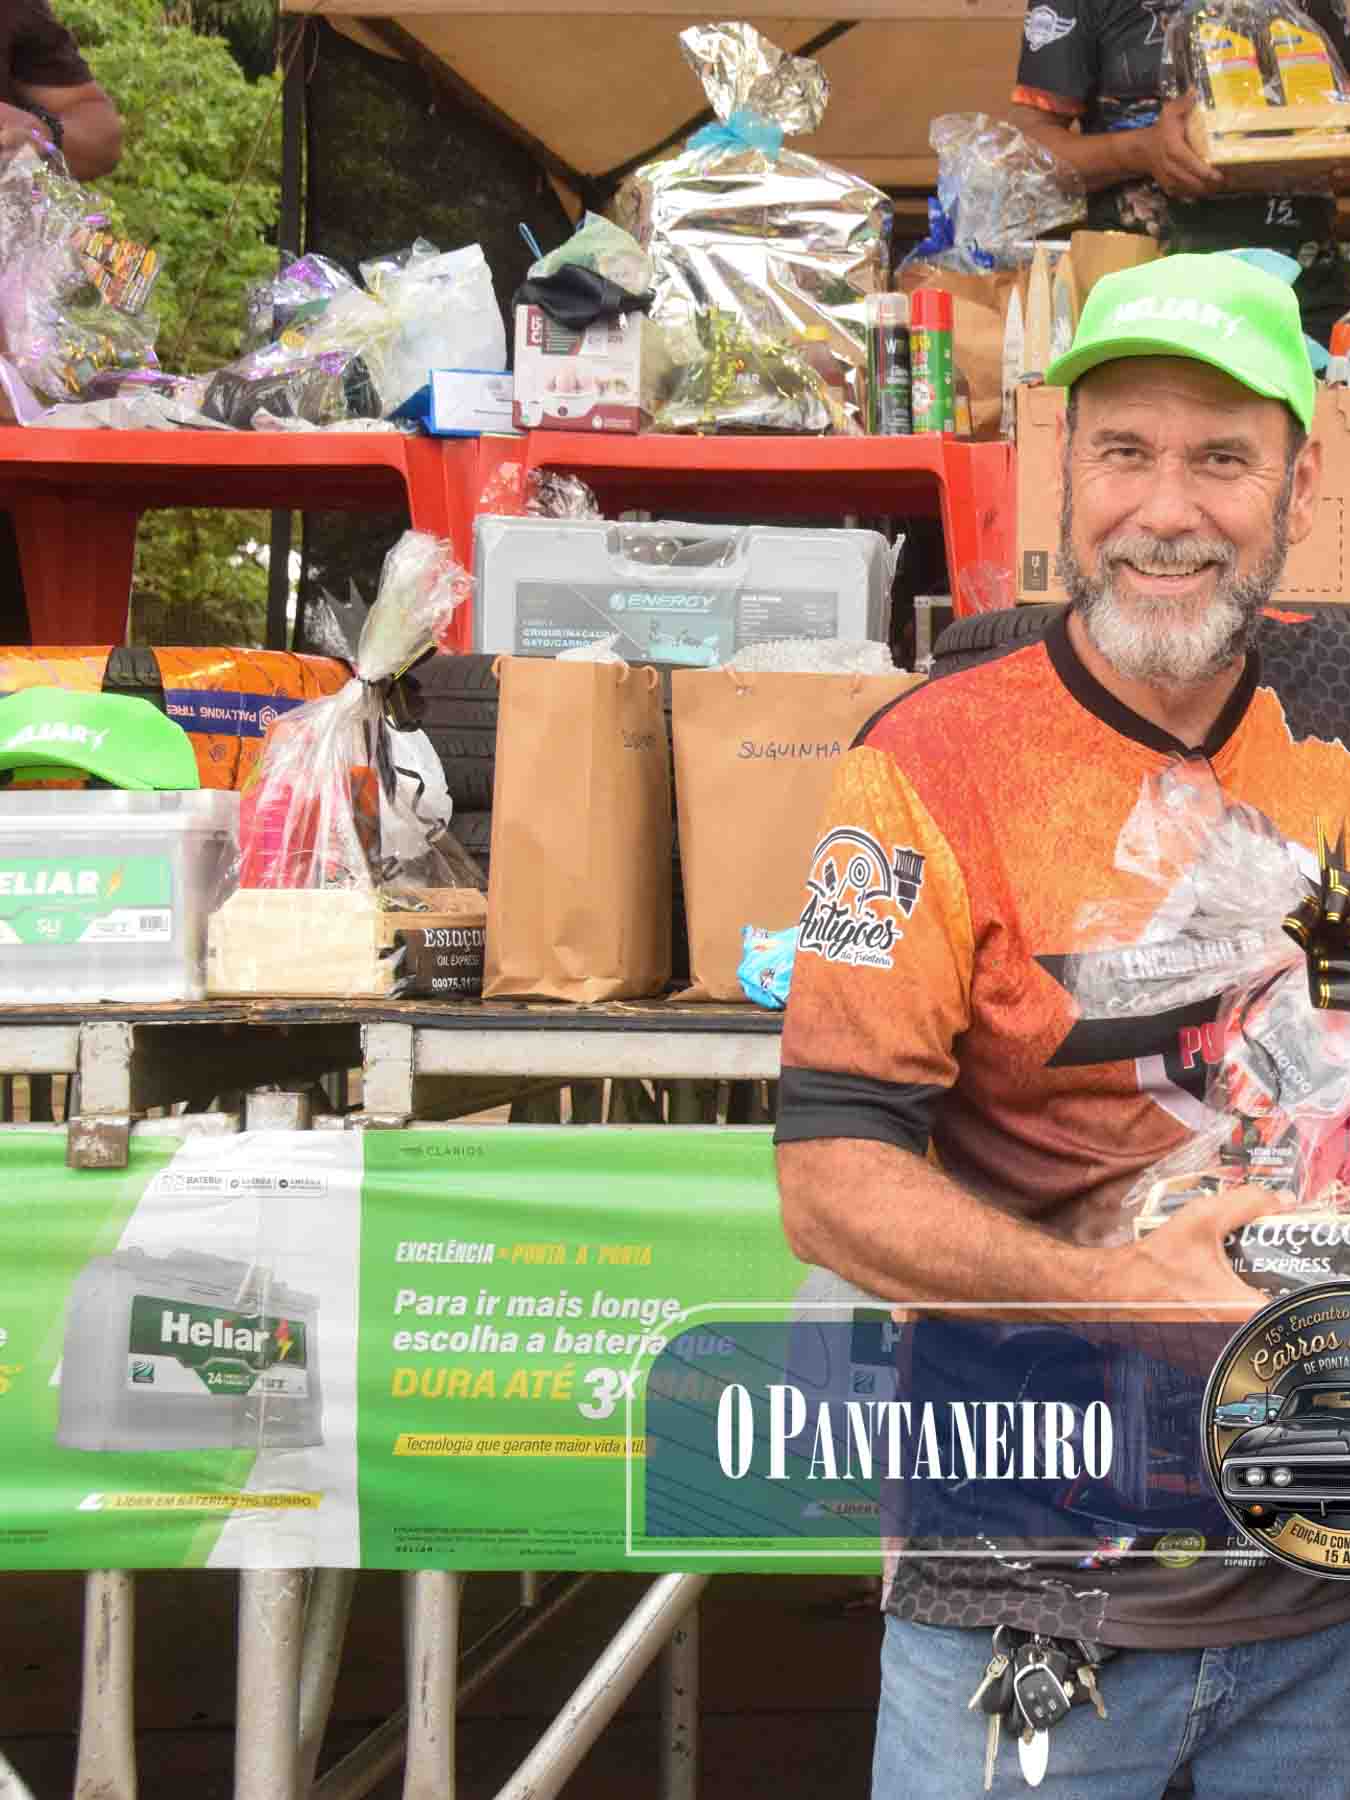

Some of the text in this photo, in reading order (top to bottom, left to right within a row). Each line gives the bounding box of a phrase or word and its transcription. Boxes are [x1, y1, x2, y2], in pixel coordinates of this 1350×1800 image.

[737, 740, 842, 761] SUGUINHA
[395, 1239, 496, 1264] EXCELÊNCIA
[1252, 1257, 1331, 1273] EXPRESS
[393, 1288, 689, 1326] Para ir mais longe,
[159, 1309, 271, 1353] Heliar
[392, 1325, 520, 1353] escolha
[524, 1333, 546, 1353] a
[552, 1326, 668, 1357] bateria
[391, 1366, 498, 1400] DURA
[503, 1361, 576, 1400] ATÉ
[405, 1436, 474, 1456] Tecnologia
[475, 1440, 500, 1456] que
[502, 1441, 551, 1456] garante
[553, 1439, 591, 1454] maior
[593, 1440, 621, 1455] vida
